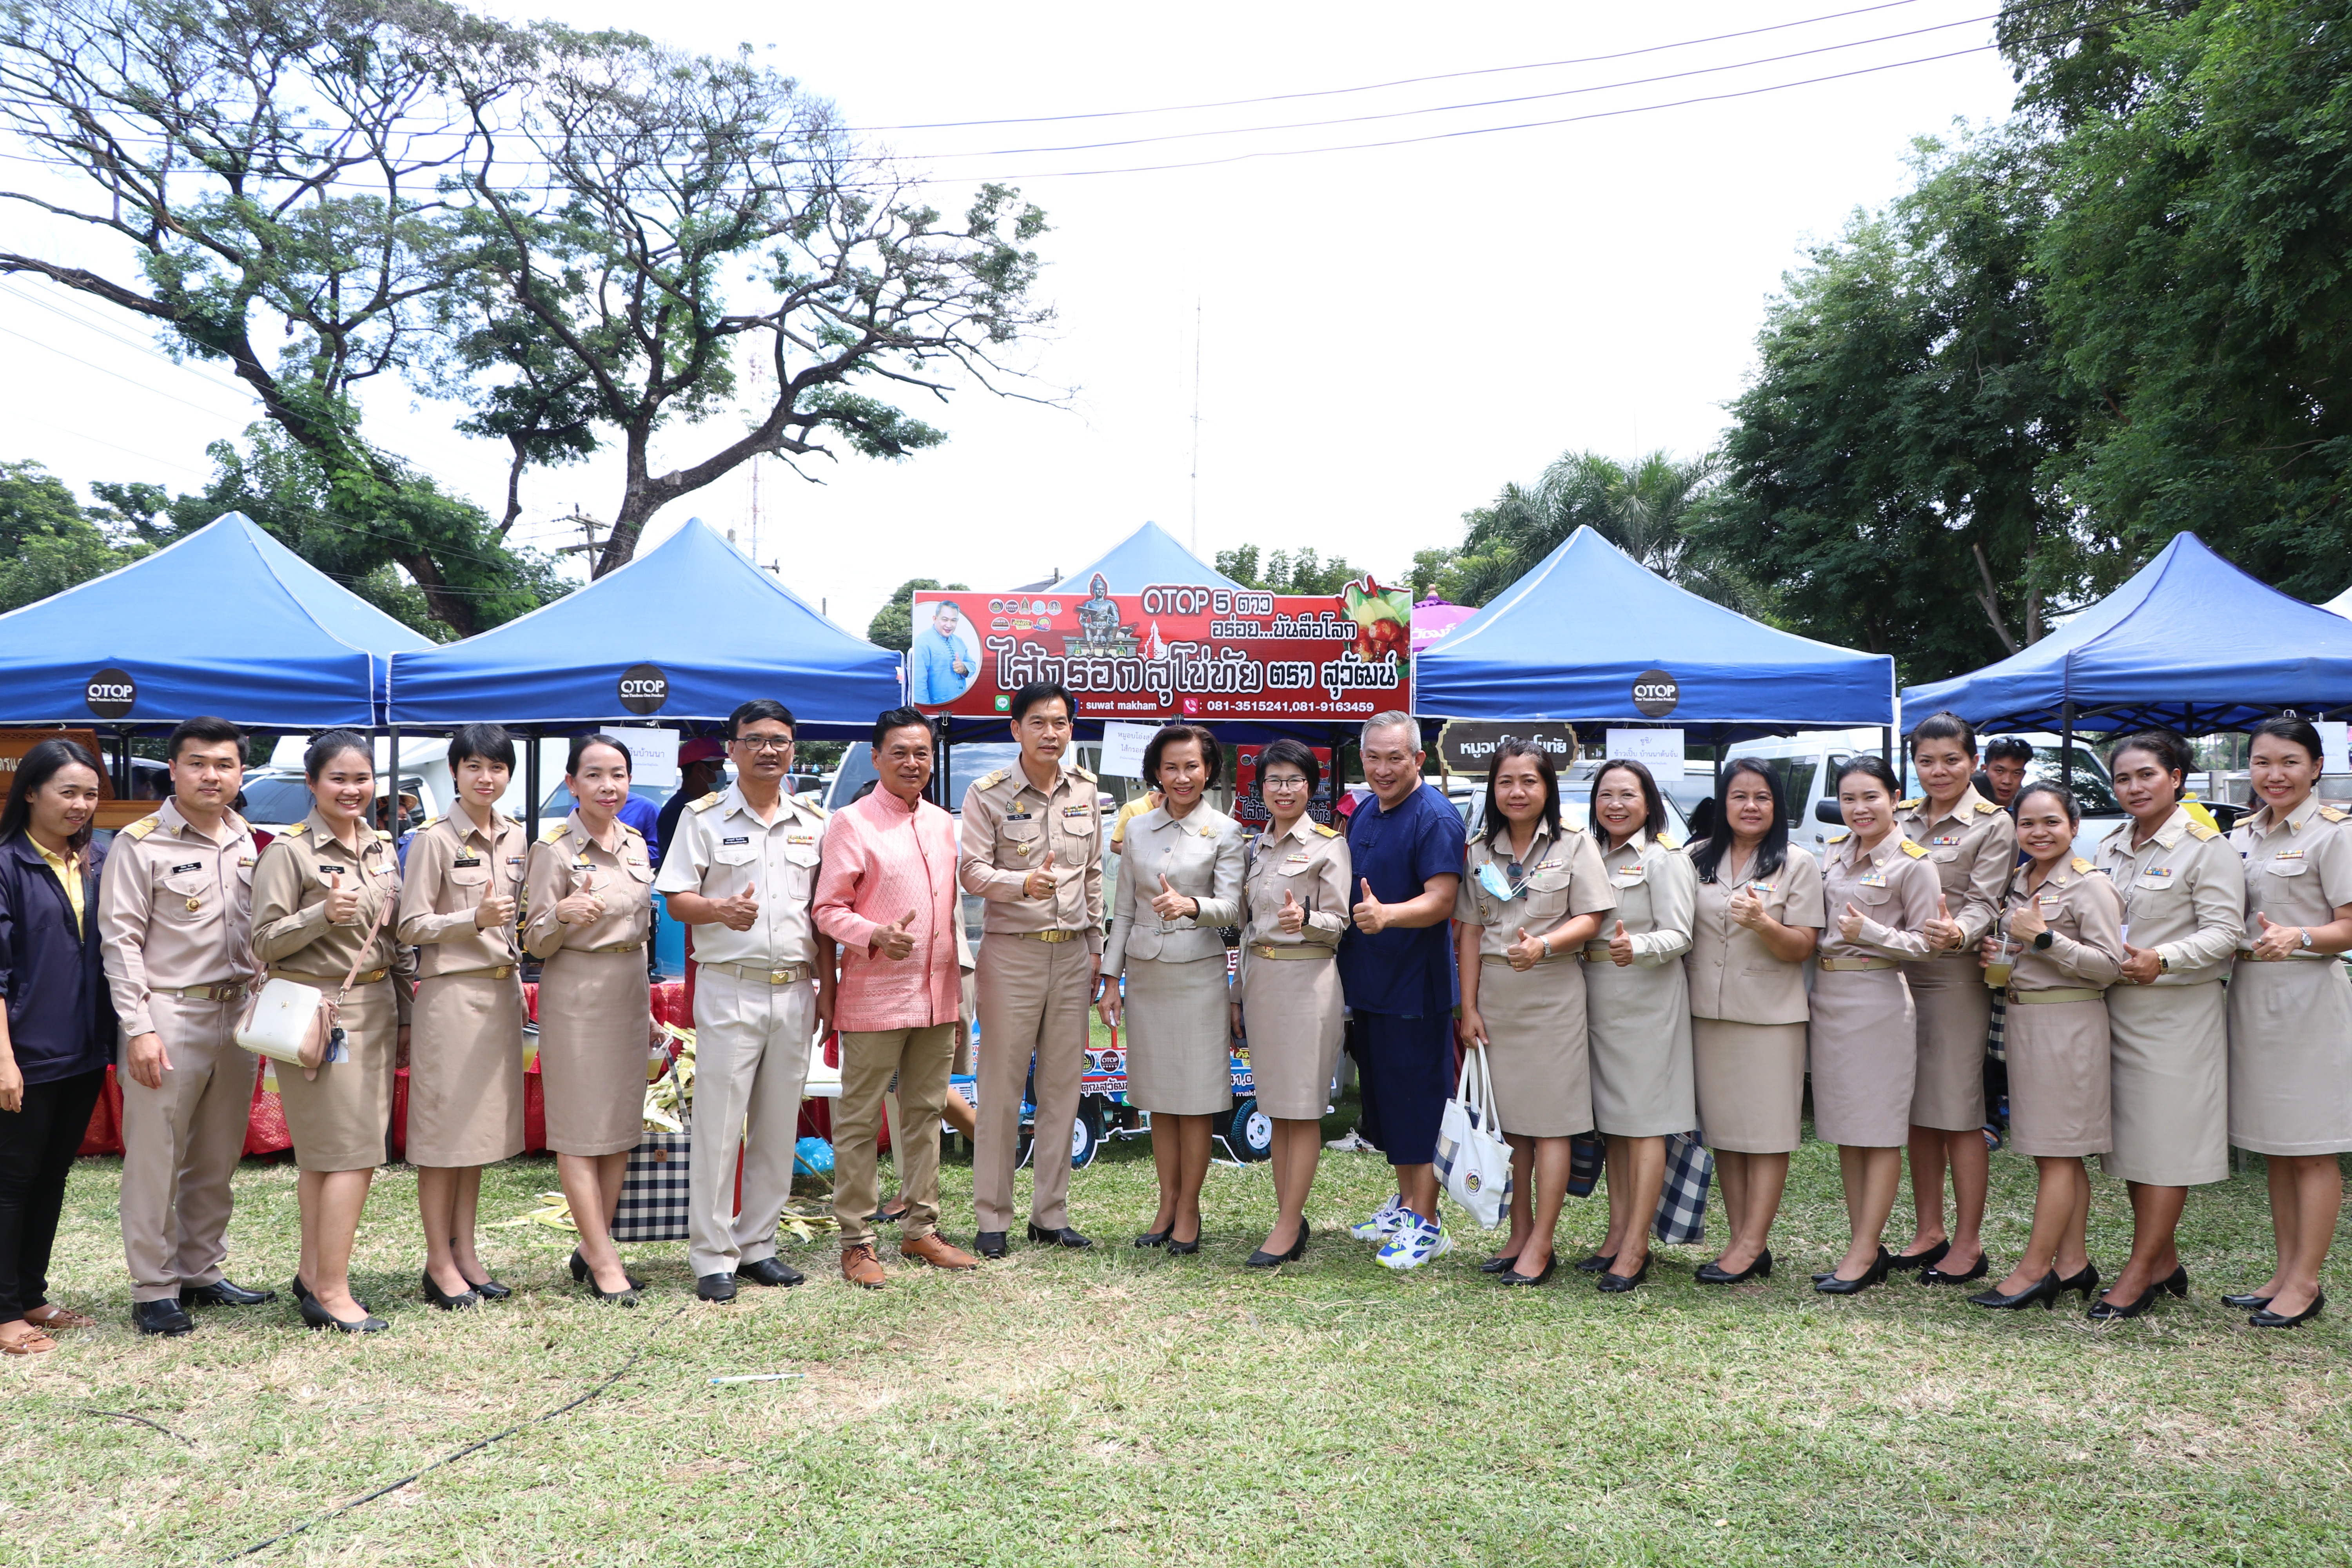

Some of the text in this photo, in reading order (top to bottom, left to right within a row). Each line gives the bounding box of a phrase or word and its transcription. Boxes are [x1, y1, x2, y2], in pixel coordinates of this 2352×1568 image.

[1143, 588, 1272, 614] OTOP 5 ดาว
[1211, 613, 1357, 639] อร่อย...บันลือโลก
[1267, 662, 1314, 688] ตรา
[1321, 650, 1399, 700] สุวัฒน์
[88, 684, 133, 697] OTOP
[621, 680, 665, 693] OTOP
[1634, 684, 1676, 697] OTOP
[1086, 701, 1114, 710] suwat
[1117, 700, 1157, 710] makham
[1207, 701, 1374, 713] 081-3515241,081-9163459
[1118, 731, 1155, 742] หมูอบโอ่งสุโ
[1121, 744, 1145, 753] ไส้กรอก
[1081, 1078, 1127, 1096] คุณสุวัฒ
